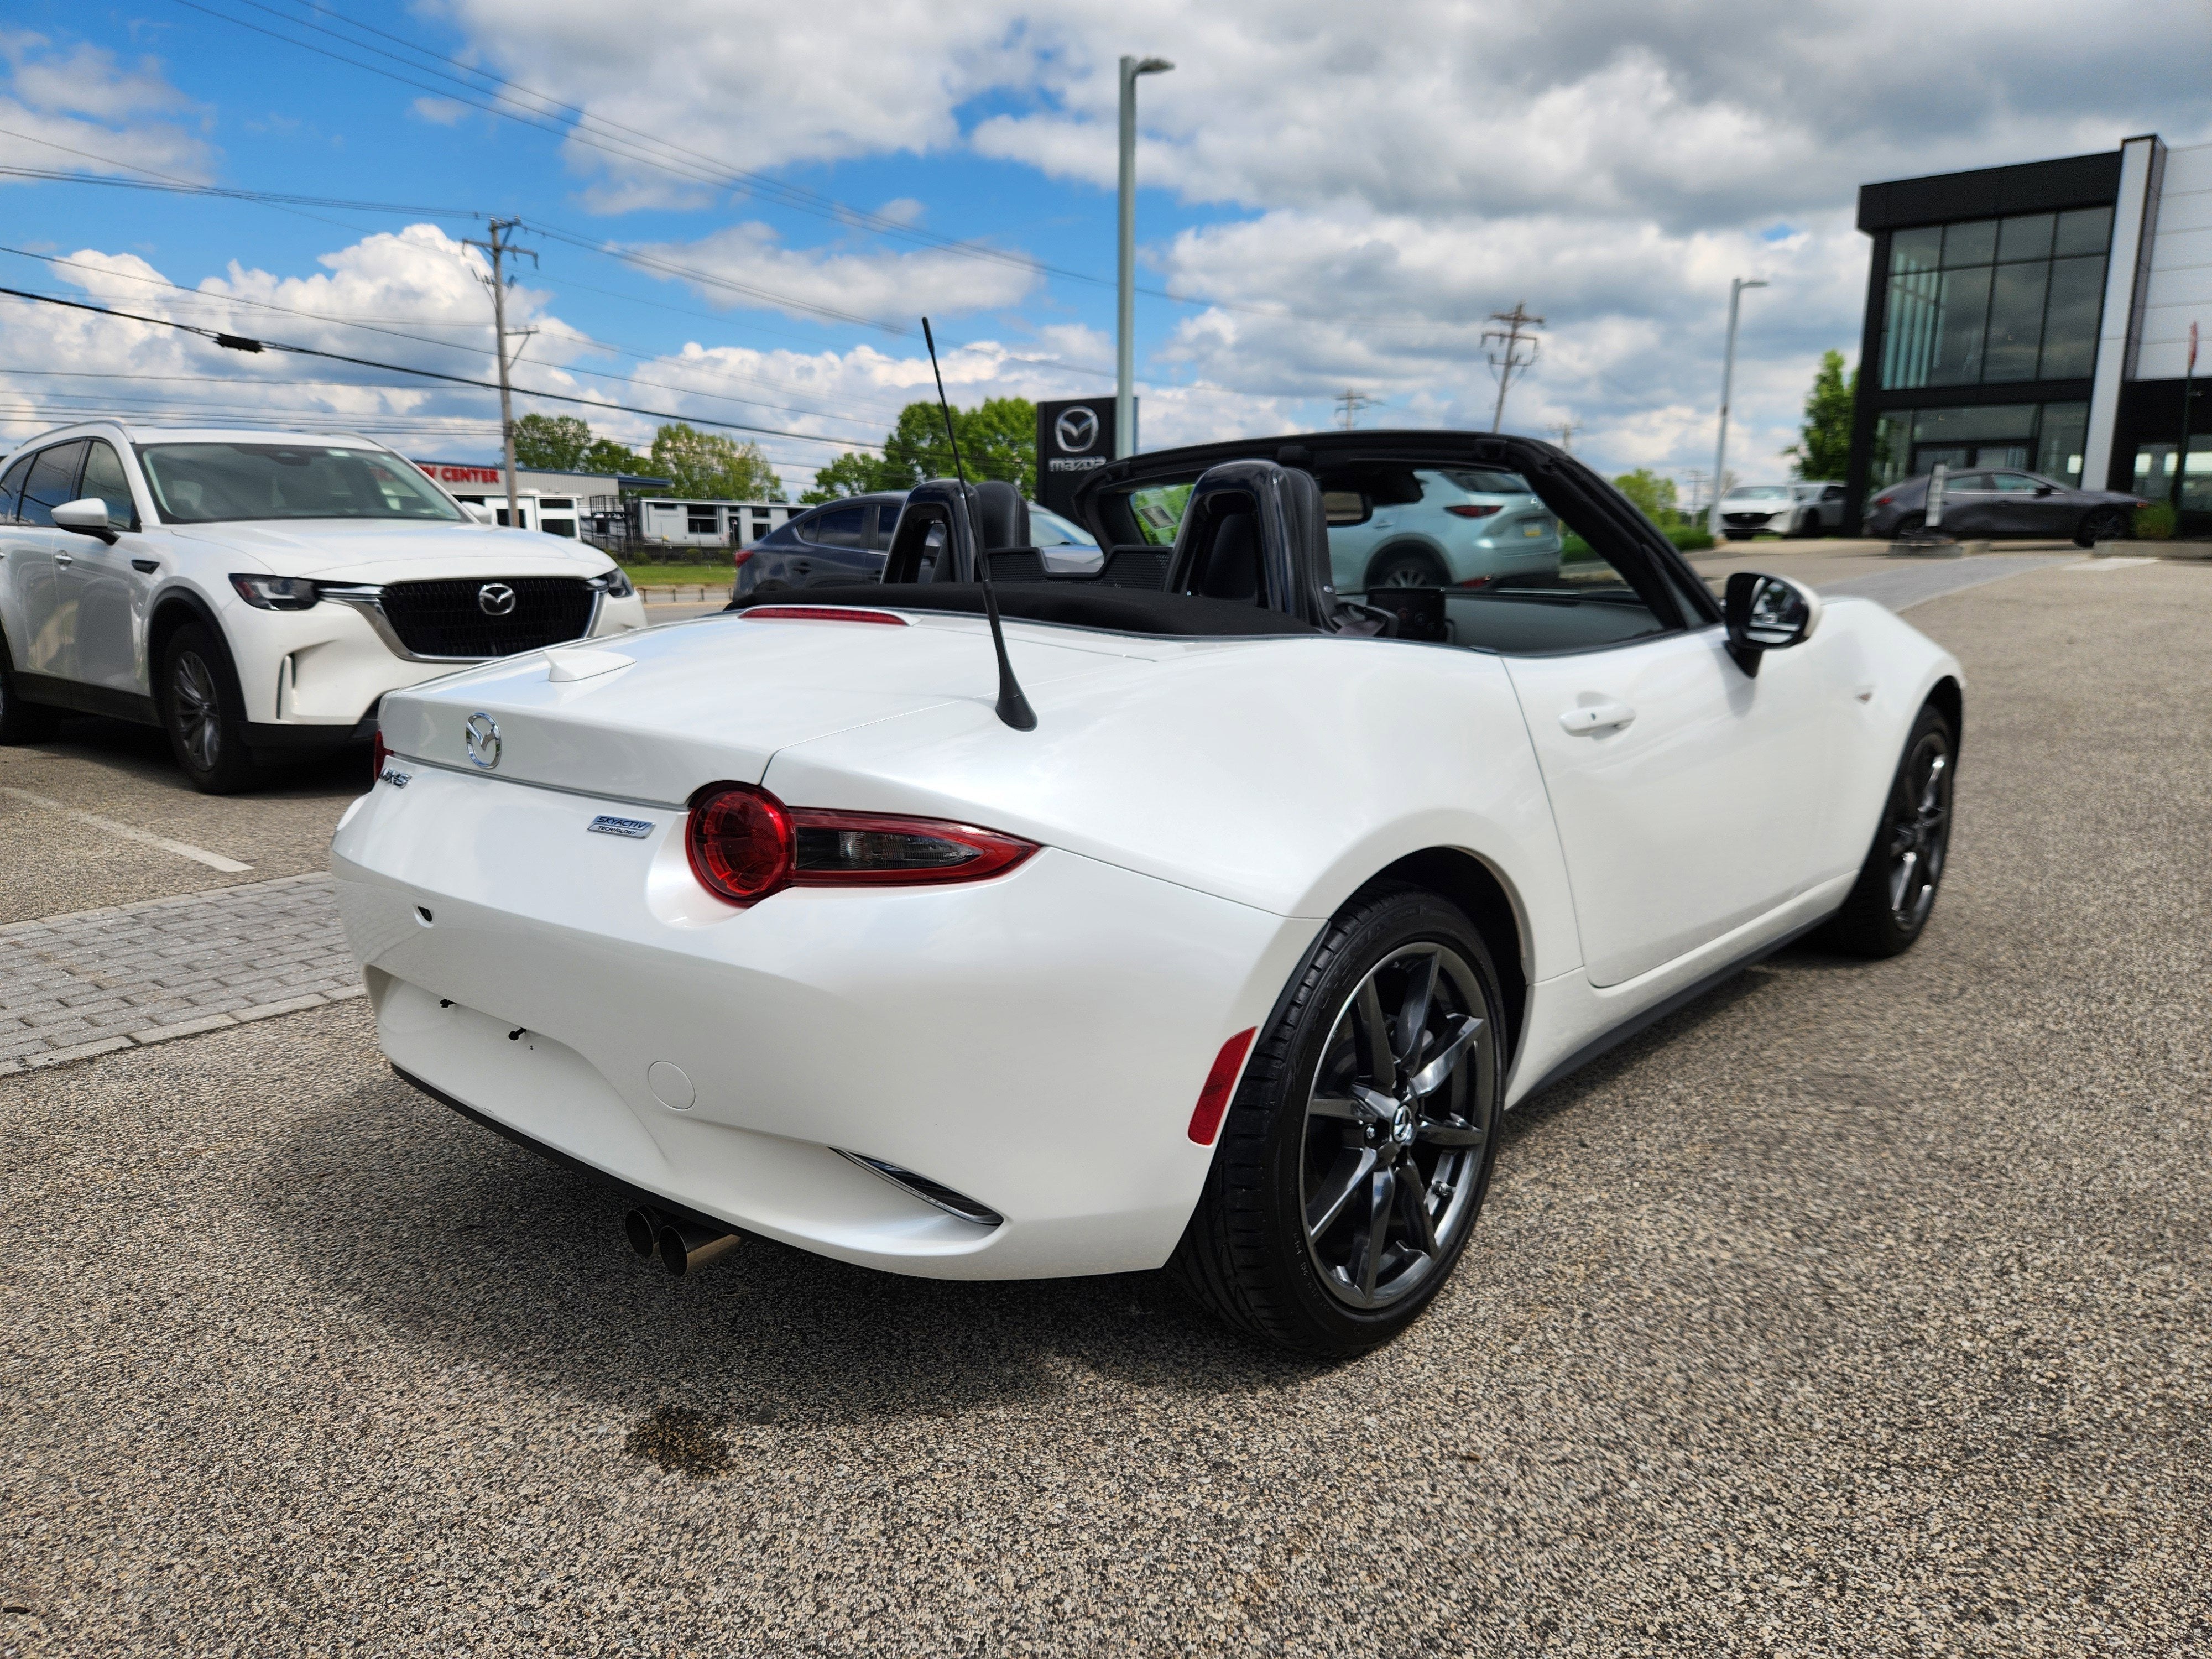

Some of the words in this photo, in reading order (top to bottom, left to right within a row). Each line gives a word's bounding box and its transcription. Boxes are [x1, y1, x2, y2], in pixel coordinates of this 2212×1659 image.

[441, 468, 499, 483] CENTER
[597, 817, 647, 828] SKYACTIV
[598, 825, 637, 835] TECHNOLOGY
